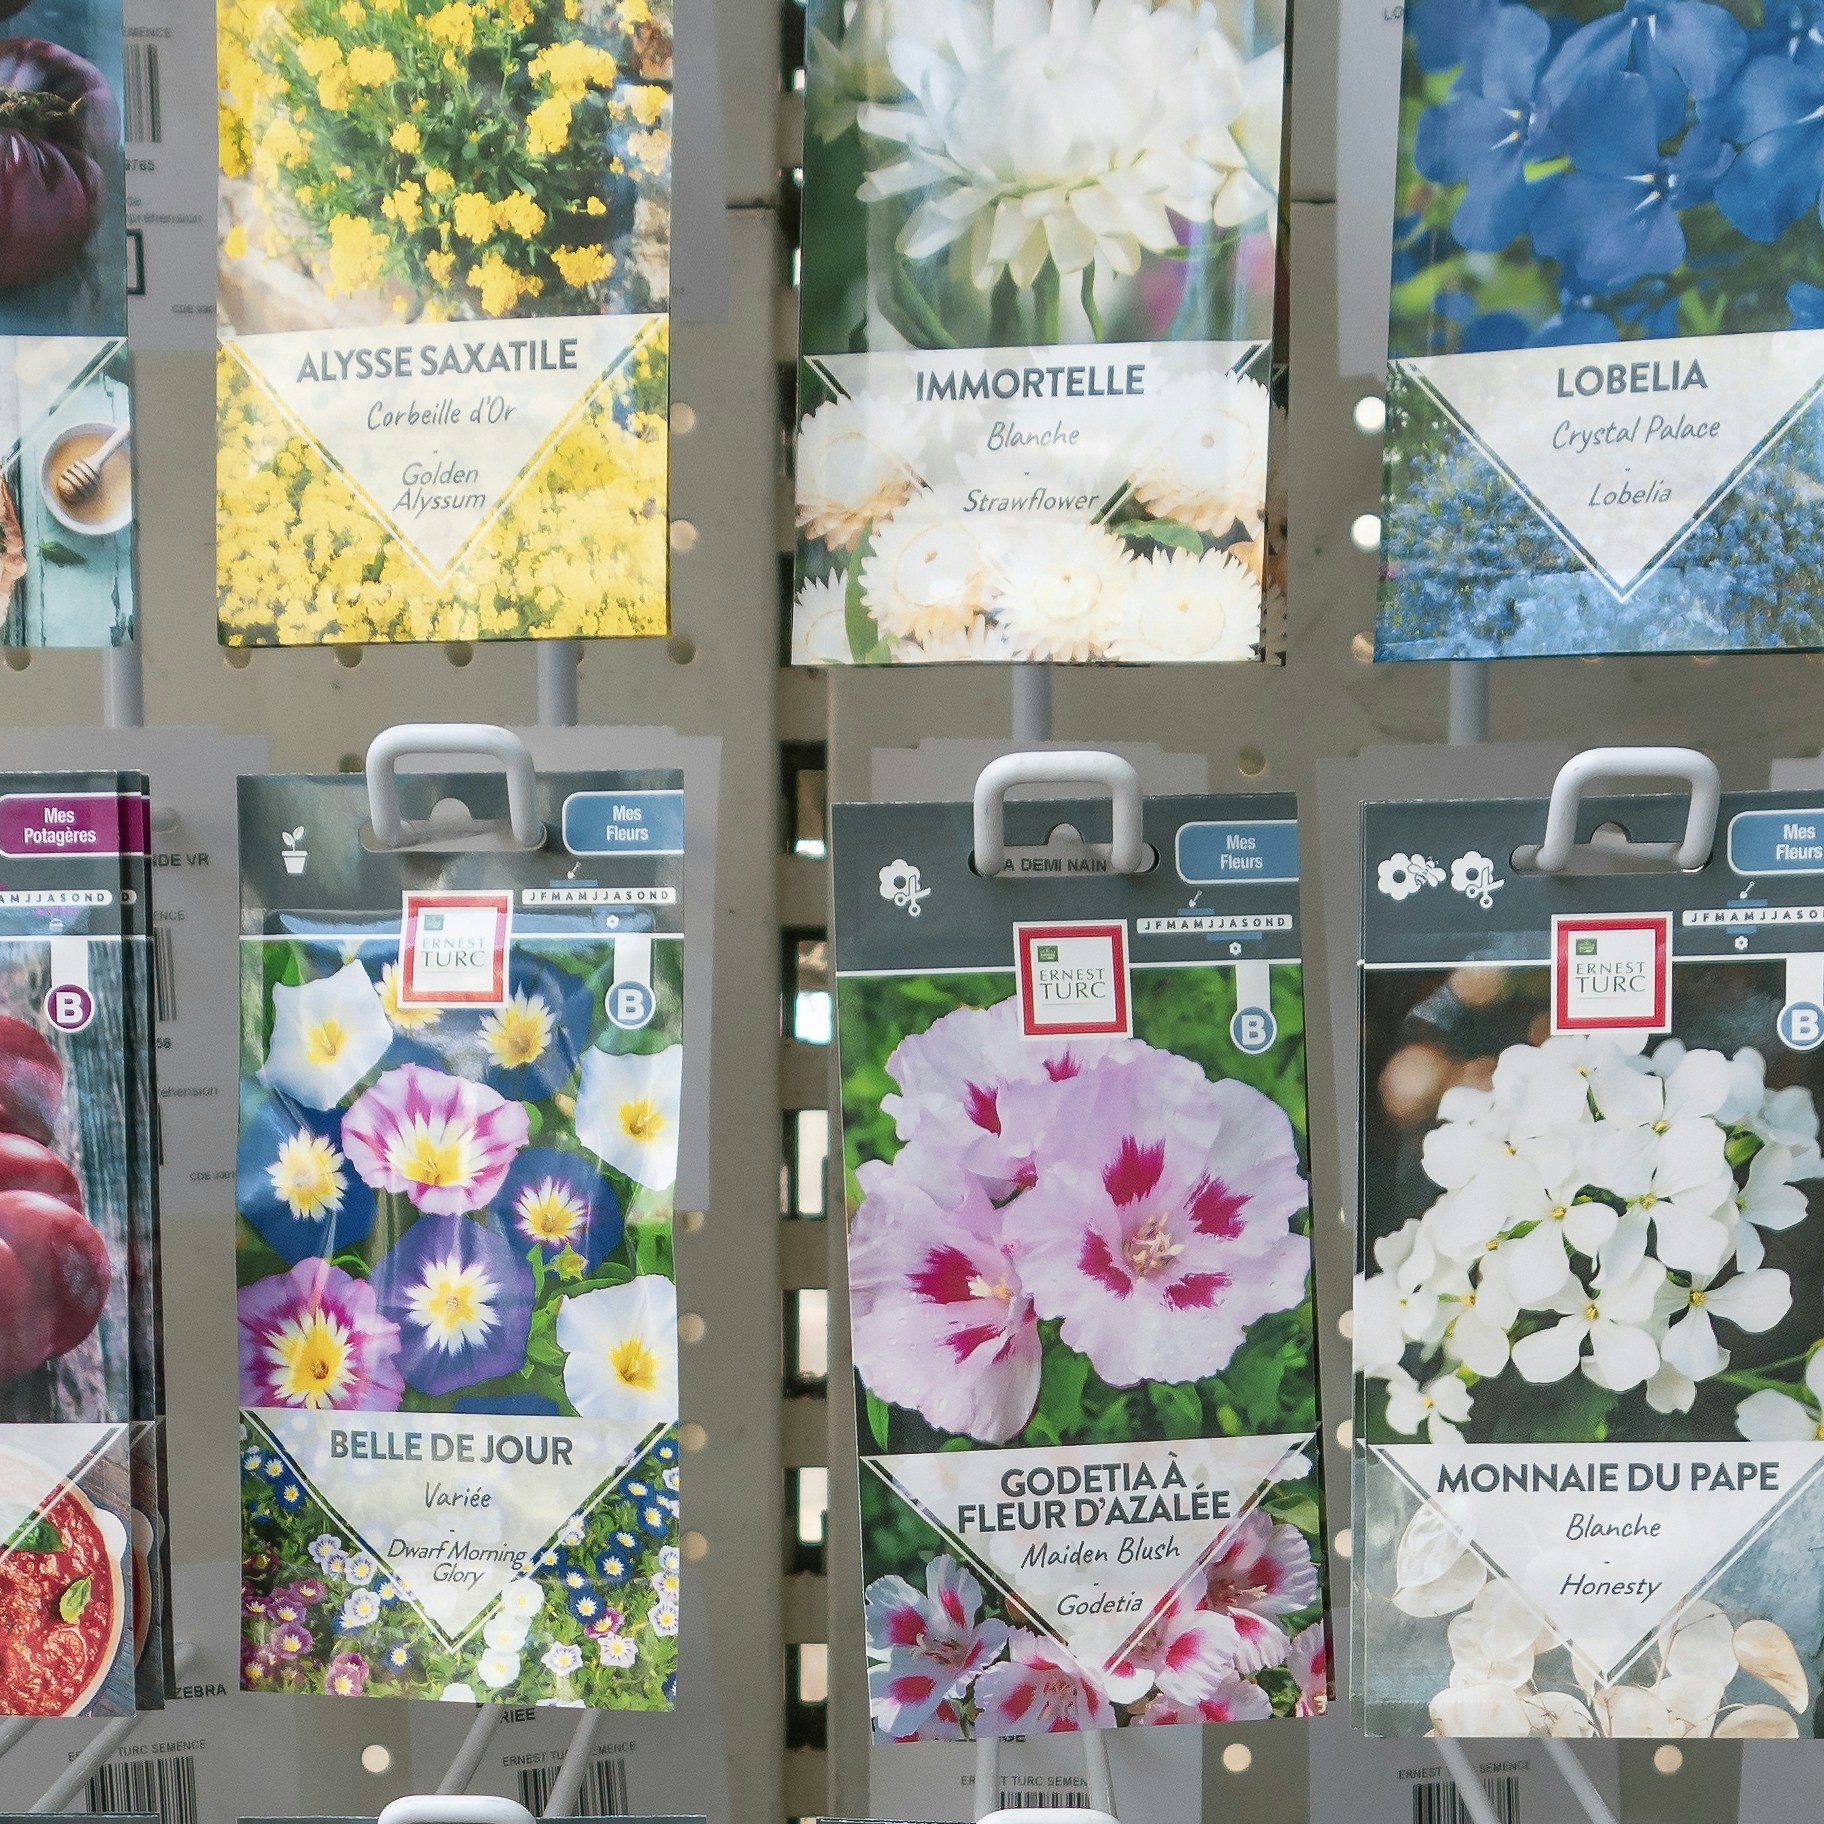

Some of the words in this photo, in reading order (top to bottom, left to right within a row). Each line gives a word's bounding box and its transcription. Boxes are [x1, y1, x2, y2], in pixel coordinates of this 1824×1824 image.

[296, 348, 413, 384] ALYSSE
[421, 338, 577, 377] SAXATILE
[916, 364, 1145, 402] IMMORTELLE
[1556, 358, 1708, 398] LOBELIA
[367, 403, 460, 430] Corbeille
[470, 397, 516, 425] d'Or
[1552, 417, 1639, 453] Crystal
[1644, 416, 1720, 442] Palace
[962, 486, 1099, 514] Strawflower
[1227, 834, 1256, 850] Mes
[1021, 858, 1062, 872] DEMI
[1068, 858, 1107, 872] NAIN
[1220, 852, 1263, 870] Fleurs
[331, 1430, 422, 1462] BELLE
[432, 1434, 474, 1463] DE
[481, 1434, 573, 1467] JOUR
[1000, 1463, 1152, 1498] GODETIA
[1161, 1450, 1187, 1489] À
[1437, 1462, 1623, 1494] MONNAIE
[1635, 1464, 1684, 1493] DU
[1691, 1462, 1779, 1493] PAPE
[424, 1484, 490, 1510] Variée
[958, 1497, 1066, 1533] FLEUR
[1075, 1482, 1230, 1527] D'AZALÉE
[1559, 1573, 1662, 1602] Honesty
[1056, 1592, 1143, 1617] Godetia
[151, 1738, 208, 1755] SEMENCE
